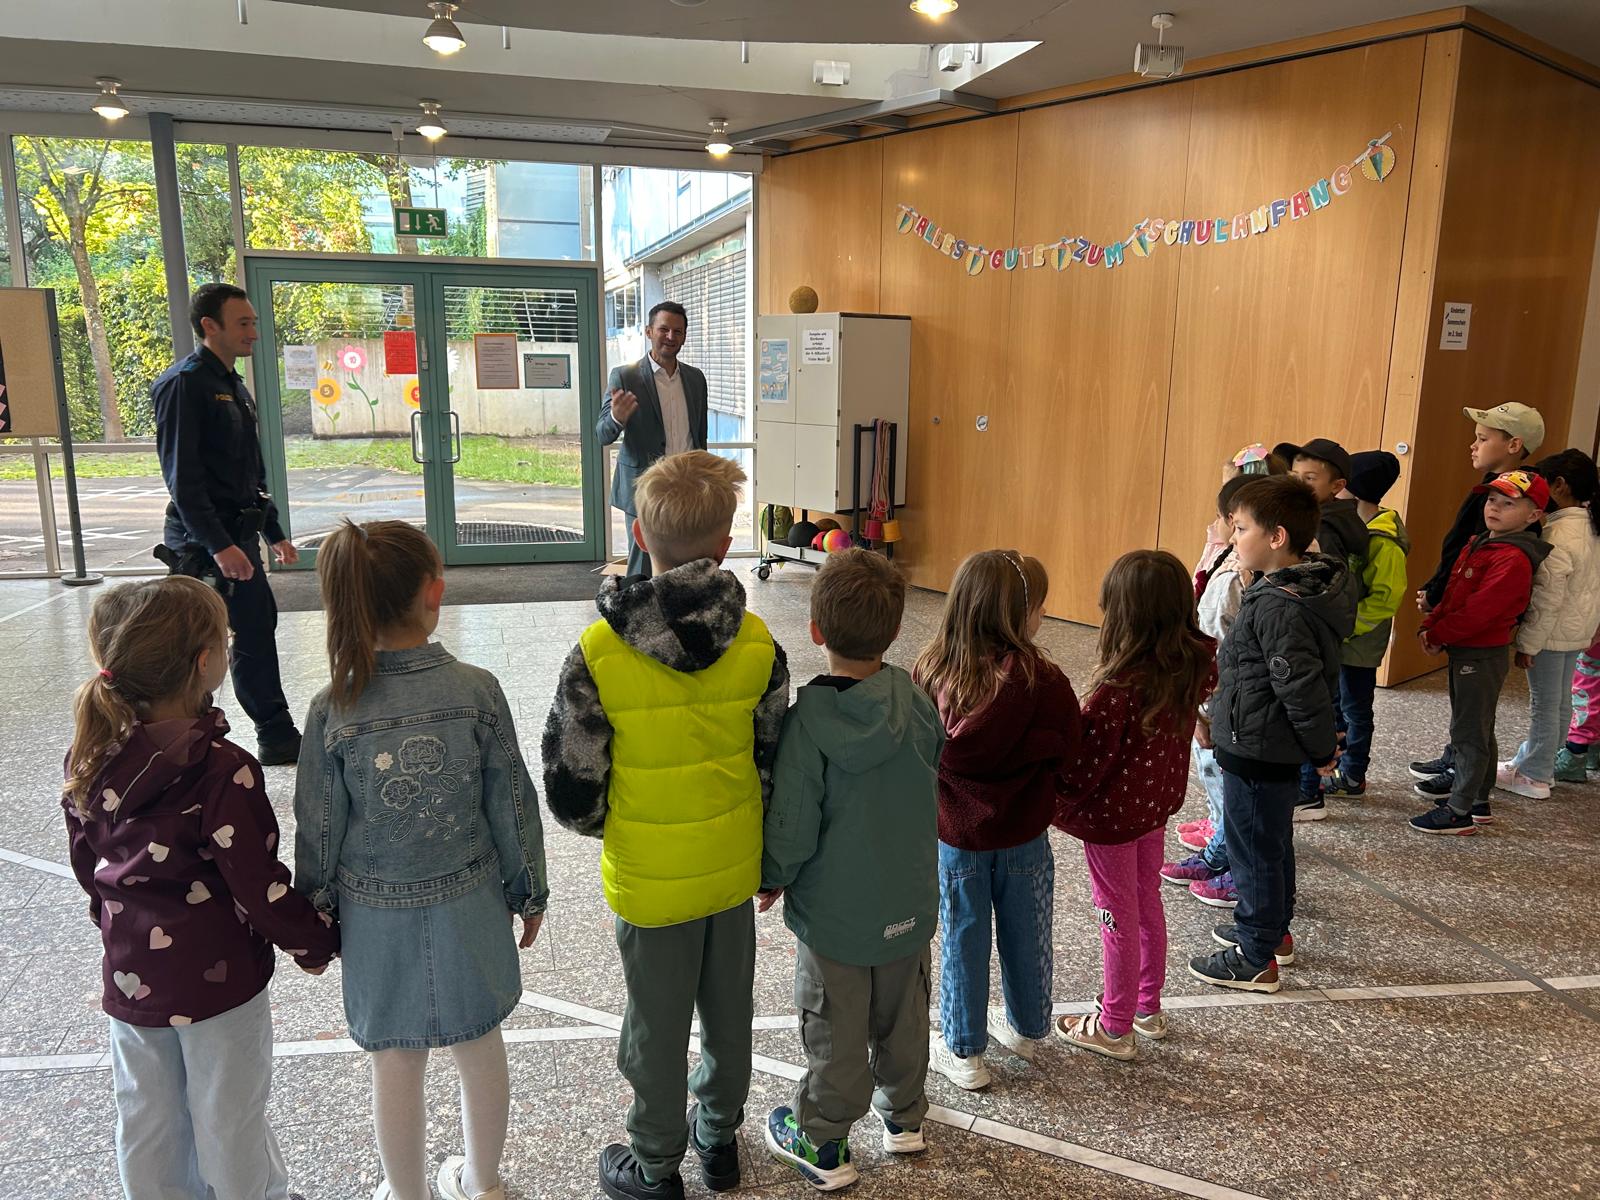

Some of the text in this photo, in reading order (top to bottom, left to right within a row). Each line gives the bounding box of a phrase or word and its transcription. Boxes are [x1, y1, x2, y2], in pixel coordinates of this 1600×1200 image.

[914, 164, 1352, 271] ALLES GUTE ZUM SCHULANFANG
[323, 387, 330, 395] 5
